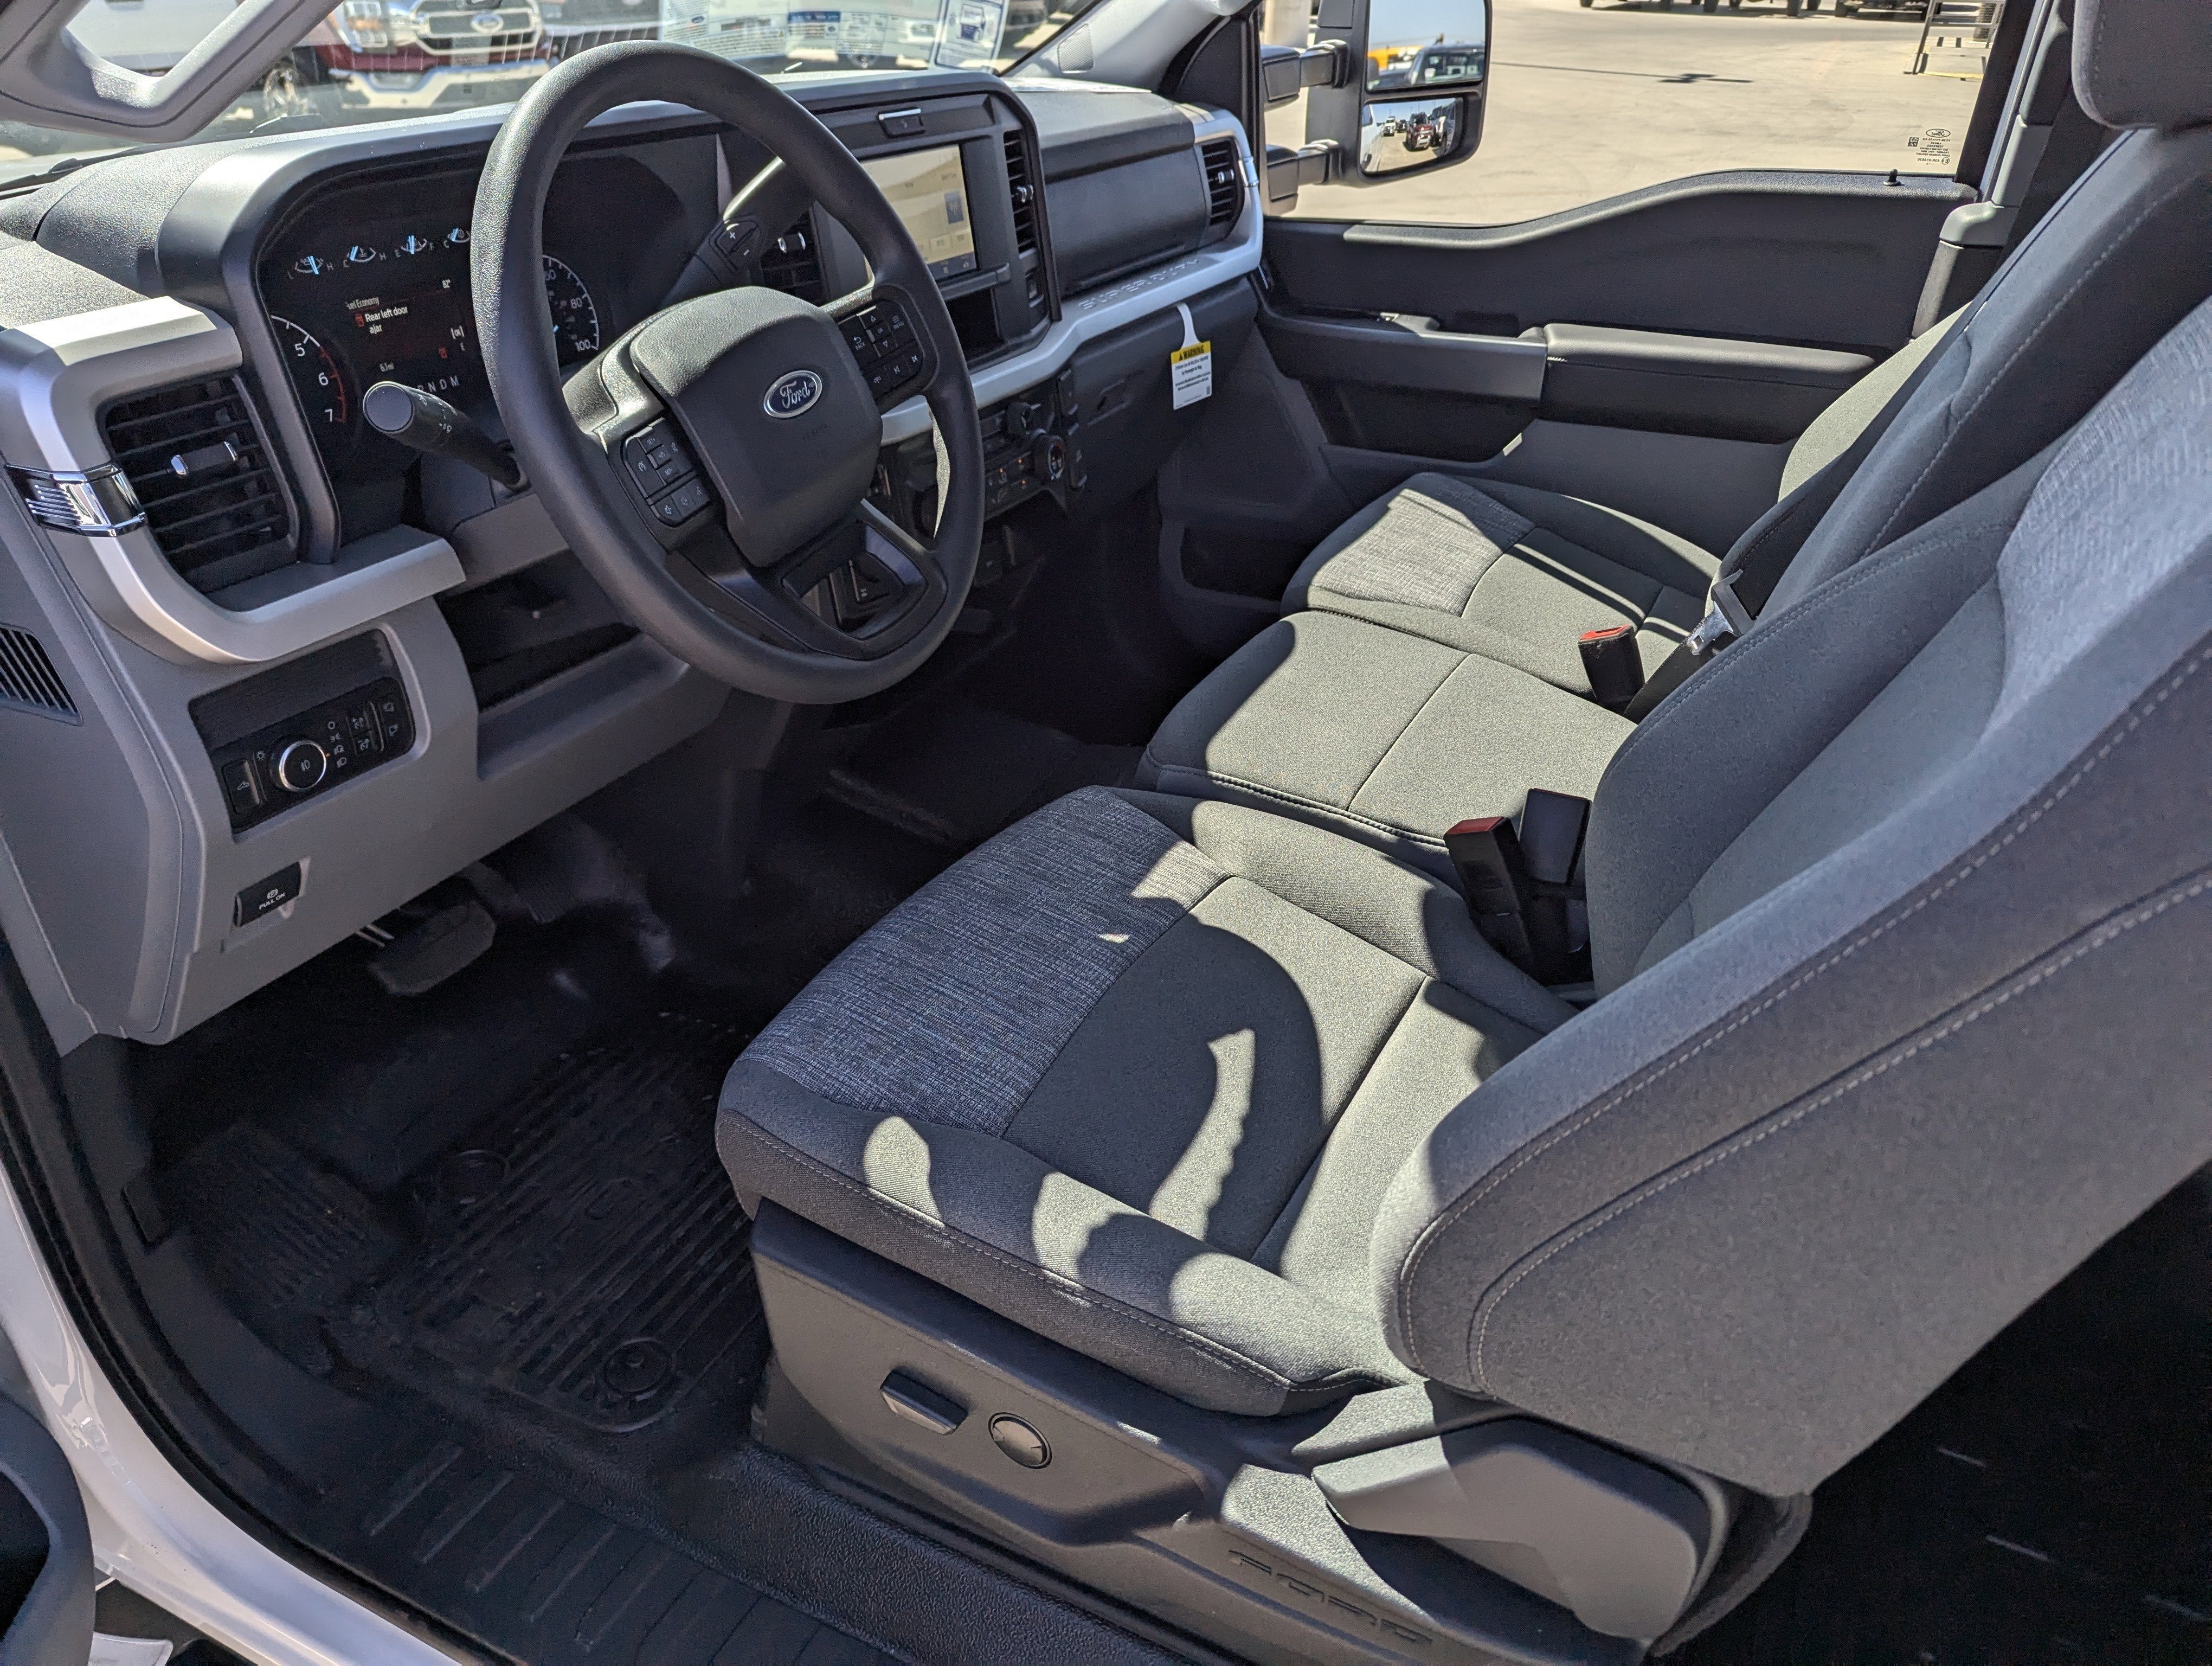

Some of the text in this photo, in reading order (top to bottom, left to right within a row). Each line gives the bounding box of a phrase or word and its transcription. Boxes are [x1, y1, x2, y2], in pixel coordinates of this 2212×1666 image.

[570, 297, 583, 309] 80
[364, 306, 408, 323] Rear left door
[369, 324, 383, 335] ajar
[294, 343, 305, 357] 5
[575, 339, 591, 352] 100
[318, 371, 329, 386] 6
[427, 380, 436, 393] N
[440, 379, 447, 390] D
[450, 375, 459, 387] M
[780, 380, 811, 409] Ford
[325, 408, 333, 422] 7
[259, 892, 286, 910] PULL ON
